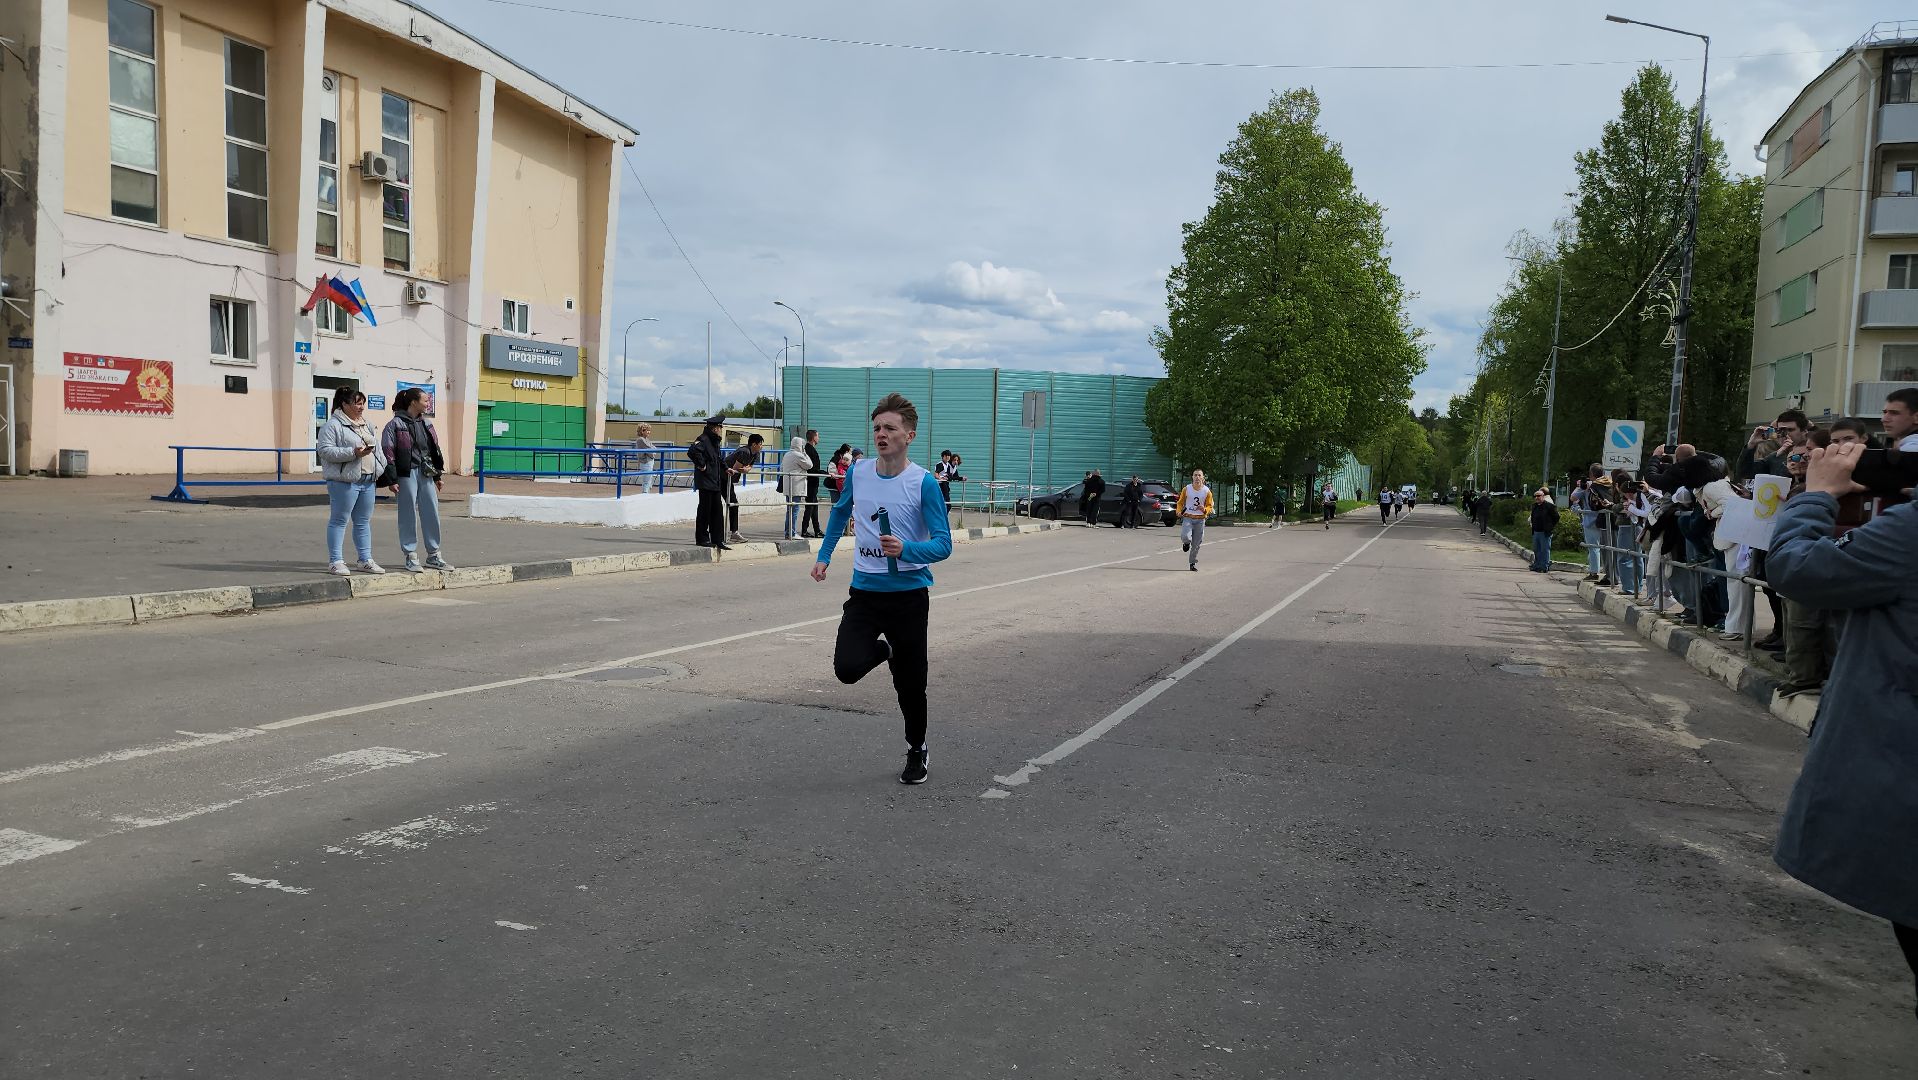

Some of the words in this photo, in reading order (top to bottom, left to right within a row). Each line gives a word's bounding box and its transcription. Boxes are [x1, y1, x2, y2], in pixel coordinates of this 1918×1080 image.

[67, 368, 74, 379] 5
[512, 378, 547, 390] ОПТИКА
[1193, 496, 1200, 507] 3
[1754, 482, 1780, 519] 9
